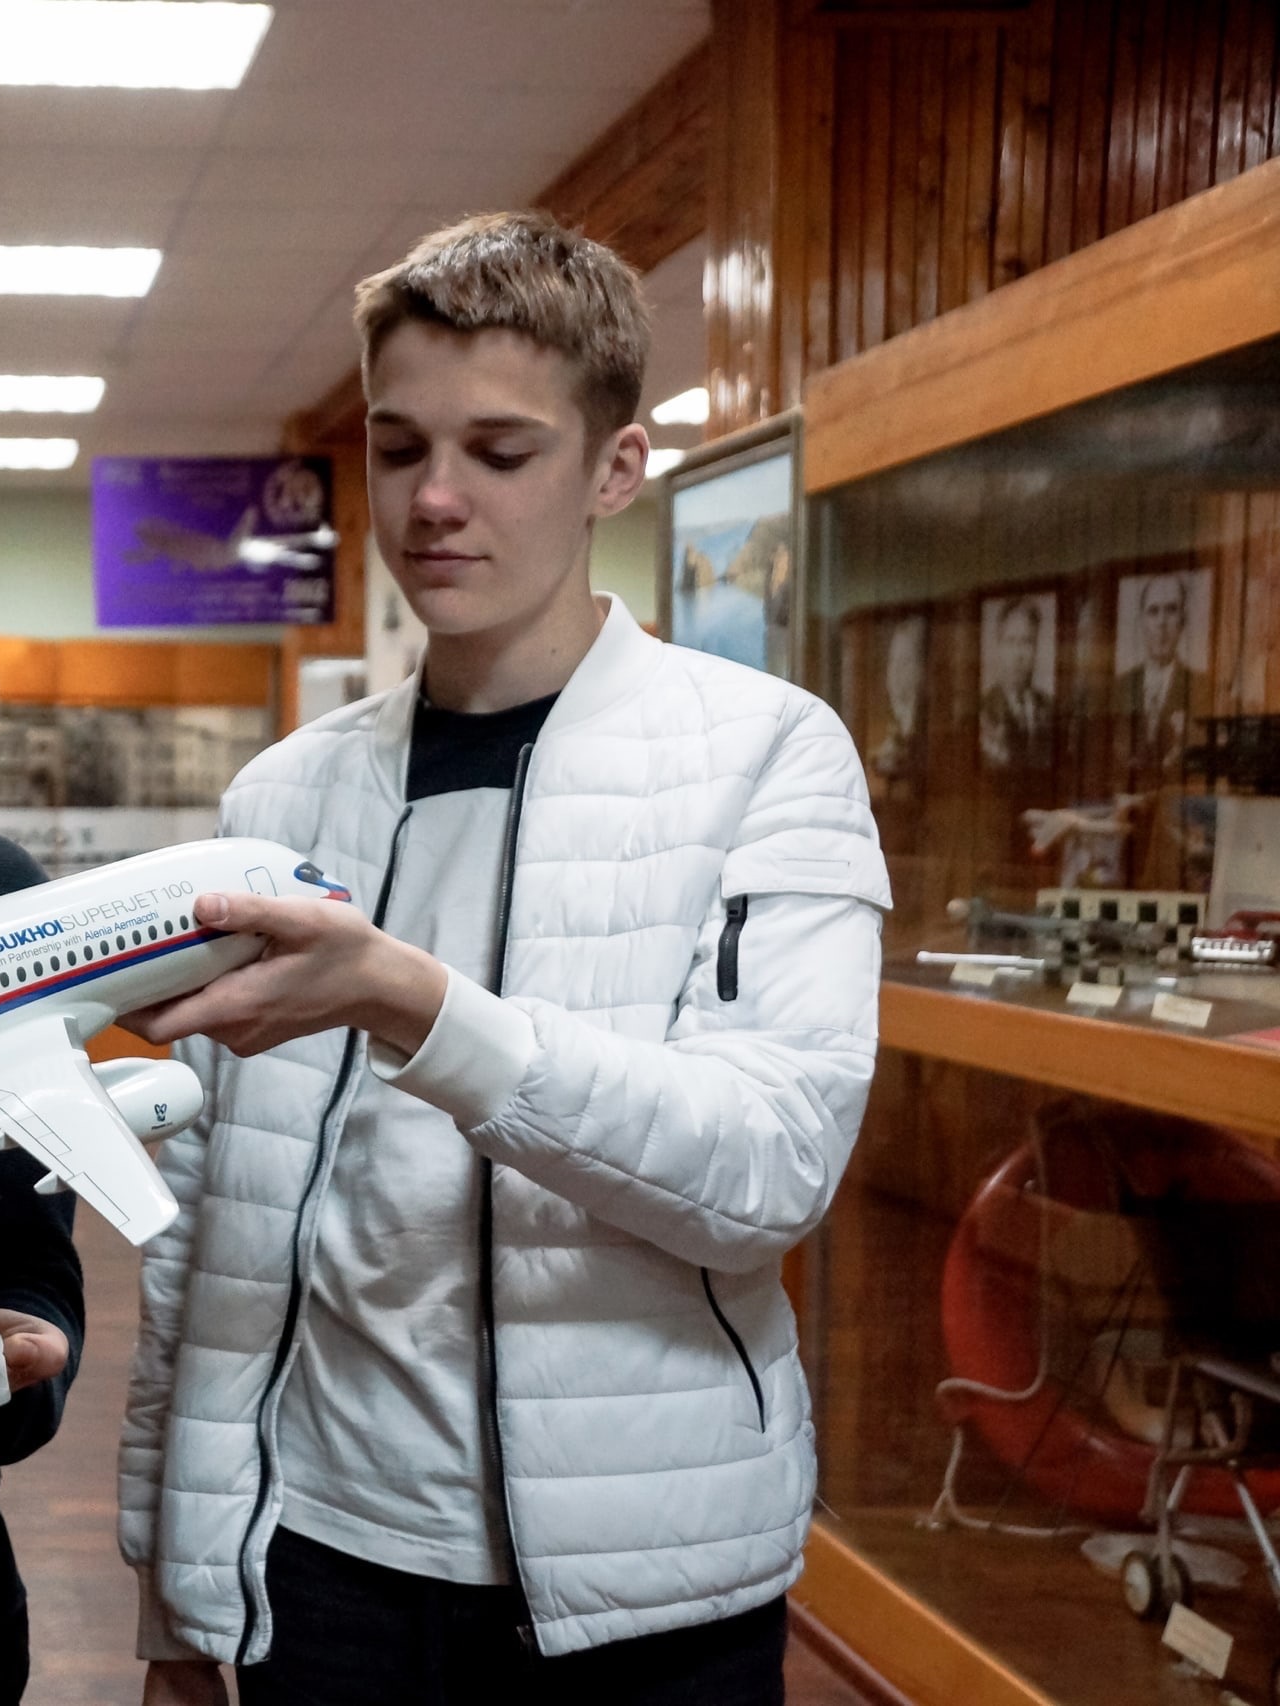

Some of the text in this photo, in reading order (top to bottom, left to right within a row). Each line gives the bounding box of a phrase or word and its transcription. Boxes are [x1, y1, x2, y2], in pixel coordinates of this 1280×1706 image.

[162, 880, 194, 901] 100
[8, 939, 62, 963] Partnership
[63, 934, 83, 948] with
[84, 926, 113, 942] Alenia
[114, 910, 160, 932] Aermacchi
